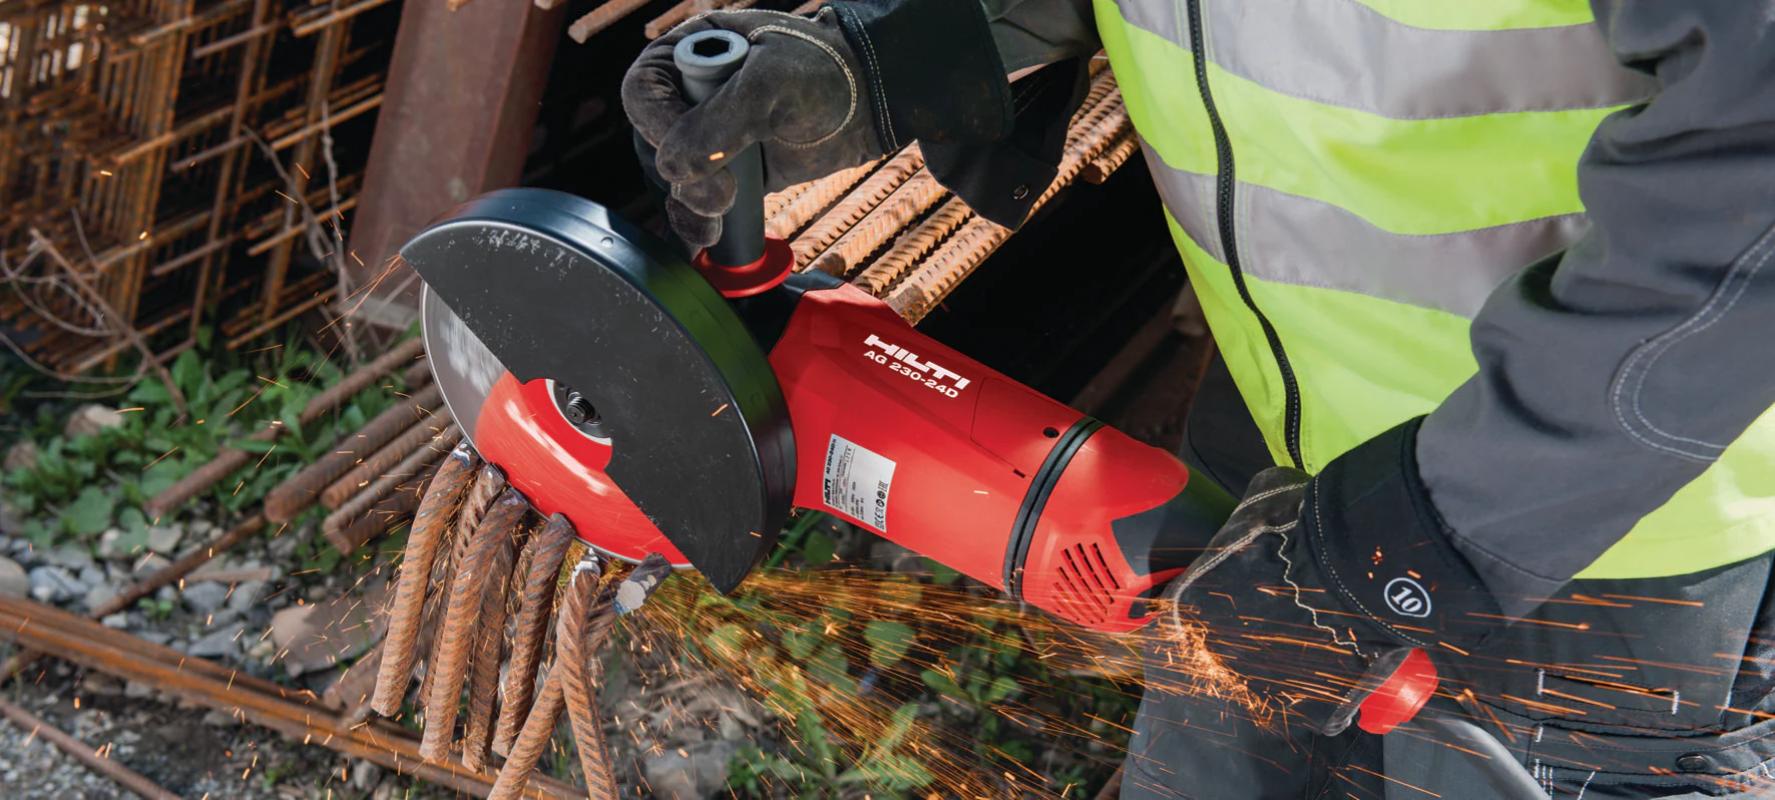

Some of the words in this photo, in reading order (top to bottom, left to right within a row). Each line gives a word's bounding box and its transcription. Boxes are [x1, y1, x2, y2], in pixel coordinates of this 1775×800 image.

[864, 334, 970, 390] HILTI
[864, 350, 887, 364] AG
[889, 362, 958, 398] 230-24D
[1391, 586, 1422, 612] 10
